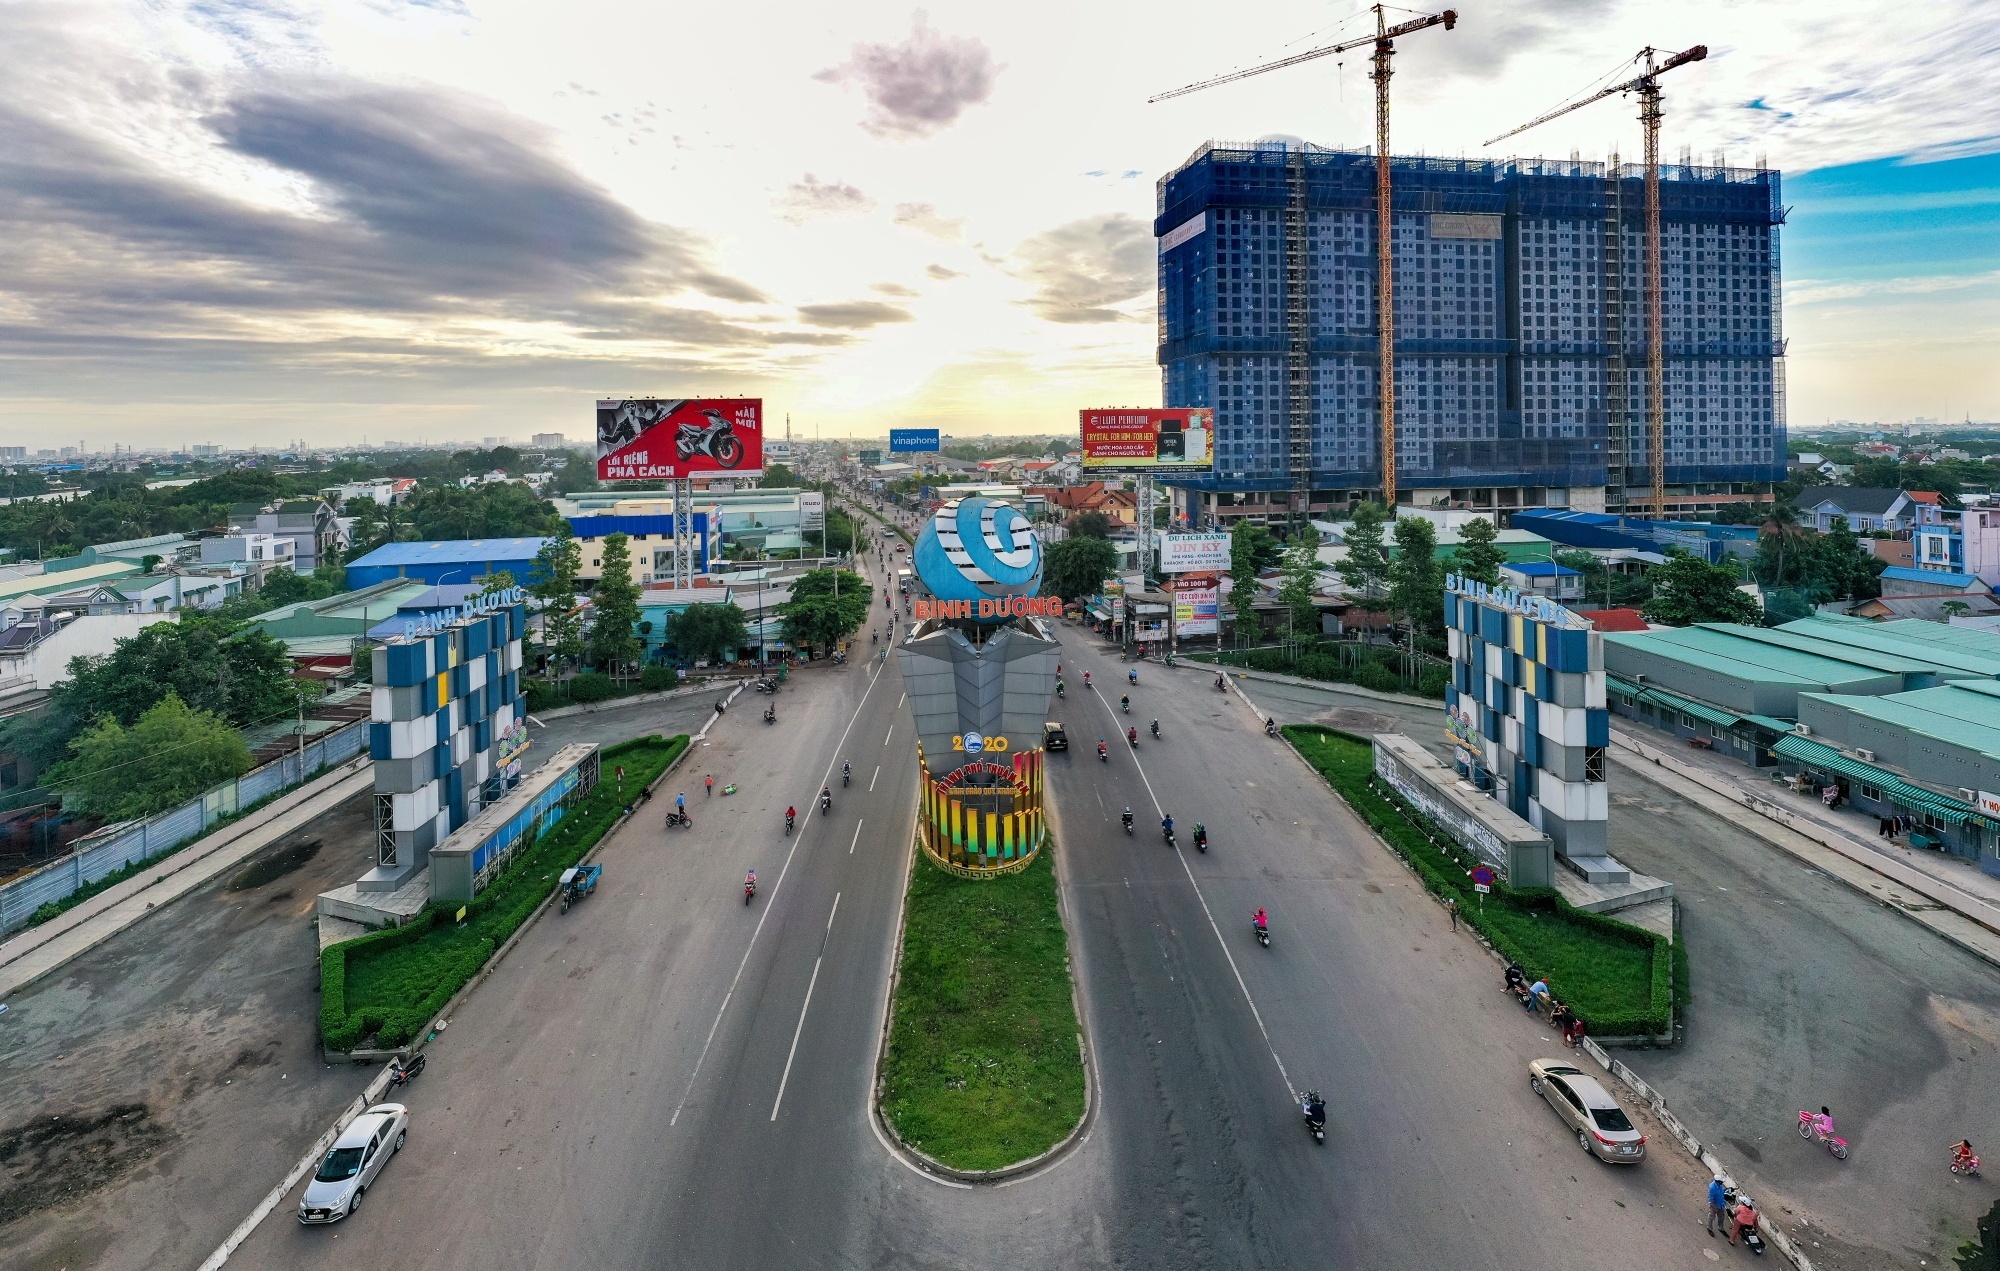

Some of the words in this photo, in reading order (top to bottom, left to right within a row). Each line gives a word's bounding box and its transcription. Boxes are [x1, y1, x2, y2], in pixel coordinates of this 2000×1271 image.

[735, 405, 755, 419] MÀU
[735, 417, 756, 430] MỚI
[1119, 416, 1149, 424] PERFUME
[892, 436, 938, 446] vinaphone
[1086, 432, 1110, 441] CRYSTAL
[1110, 432, 1120, 441] FOR
[1121, 432, 1131, 441] HIM
[1133, 432, 1143, 441] FOR
[1143, 432, 1154, 441] HER
[607, 455, 621, 466] LỐI
[623, 450, 648, 465] RIÊNG
[1136, 449, 1149, 457] VIỆT
[607, 465, 636, 478] PHÁ
[638, 464, 675, 477] CÁCH
[1182, 534, 1202, 542] LỊCH
[404, 606, 456, 640] BÌNH
[462, 584, 521, 620] DƯƠNG
[915, 594, 971, 619] BÌNH
[979, 593, 1063, 618] DƯƠNG
[1492, 586, 1568, 626] DƯƠNG
[935, 767, 965, 795] THÀNH
[964, 757, 984, 775] PHỐ
[985, 761, 1018, 783] THUẬN
[1014, 779, 1031, 795] AN
[1981, 798, 1987, 809] Y
[1989, 800, 2000, 814] HỌ
